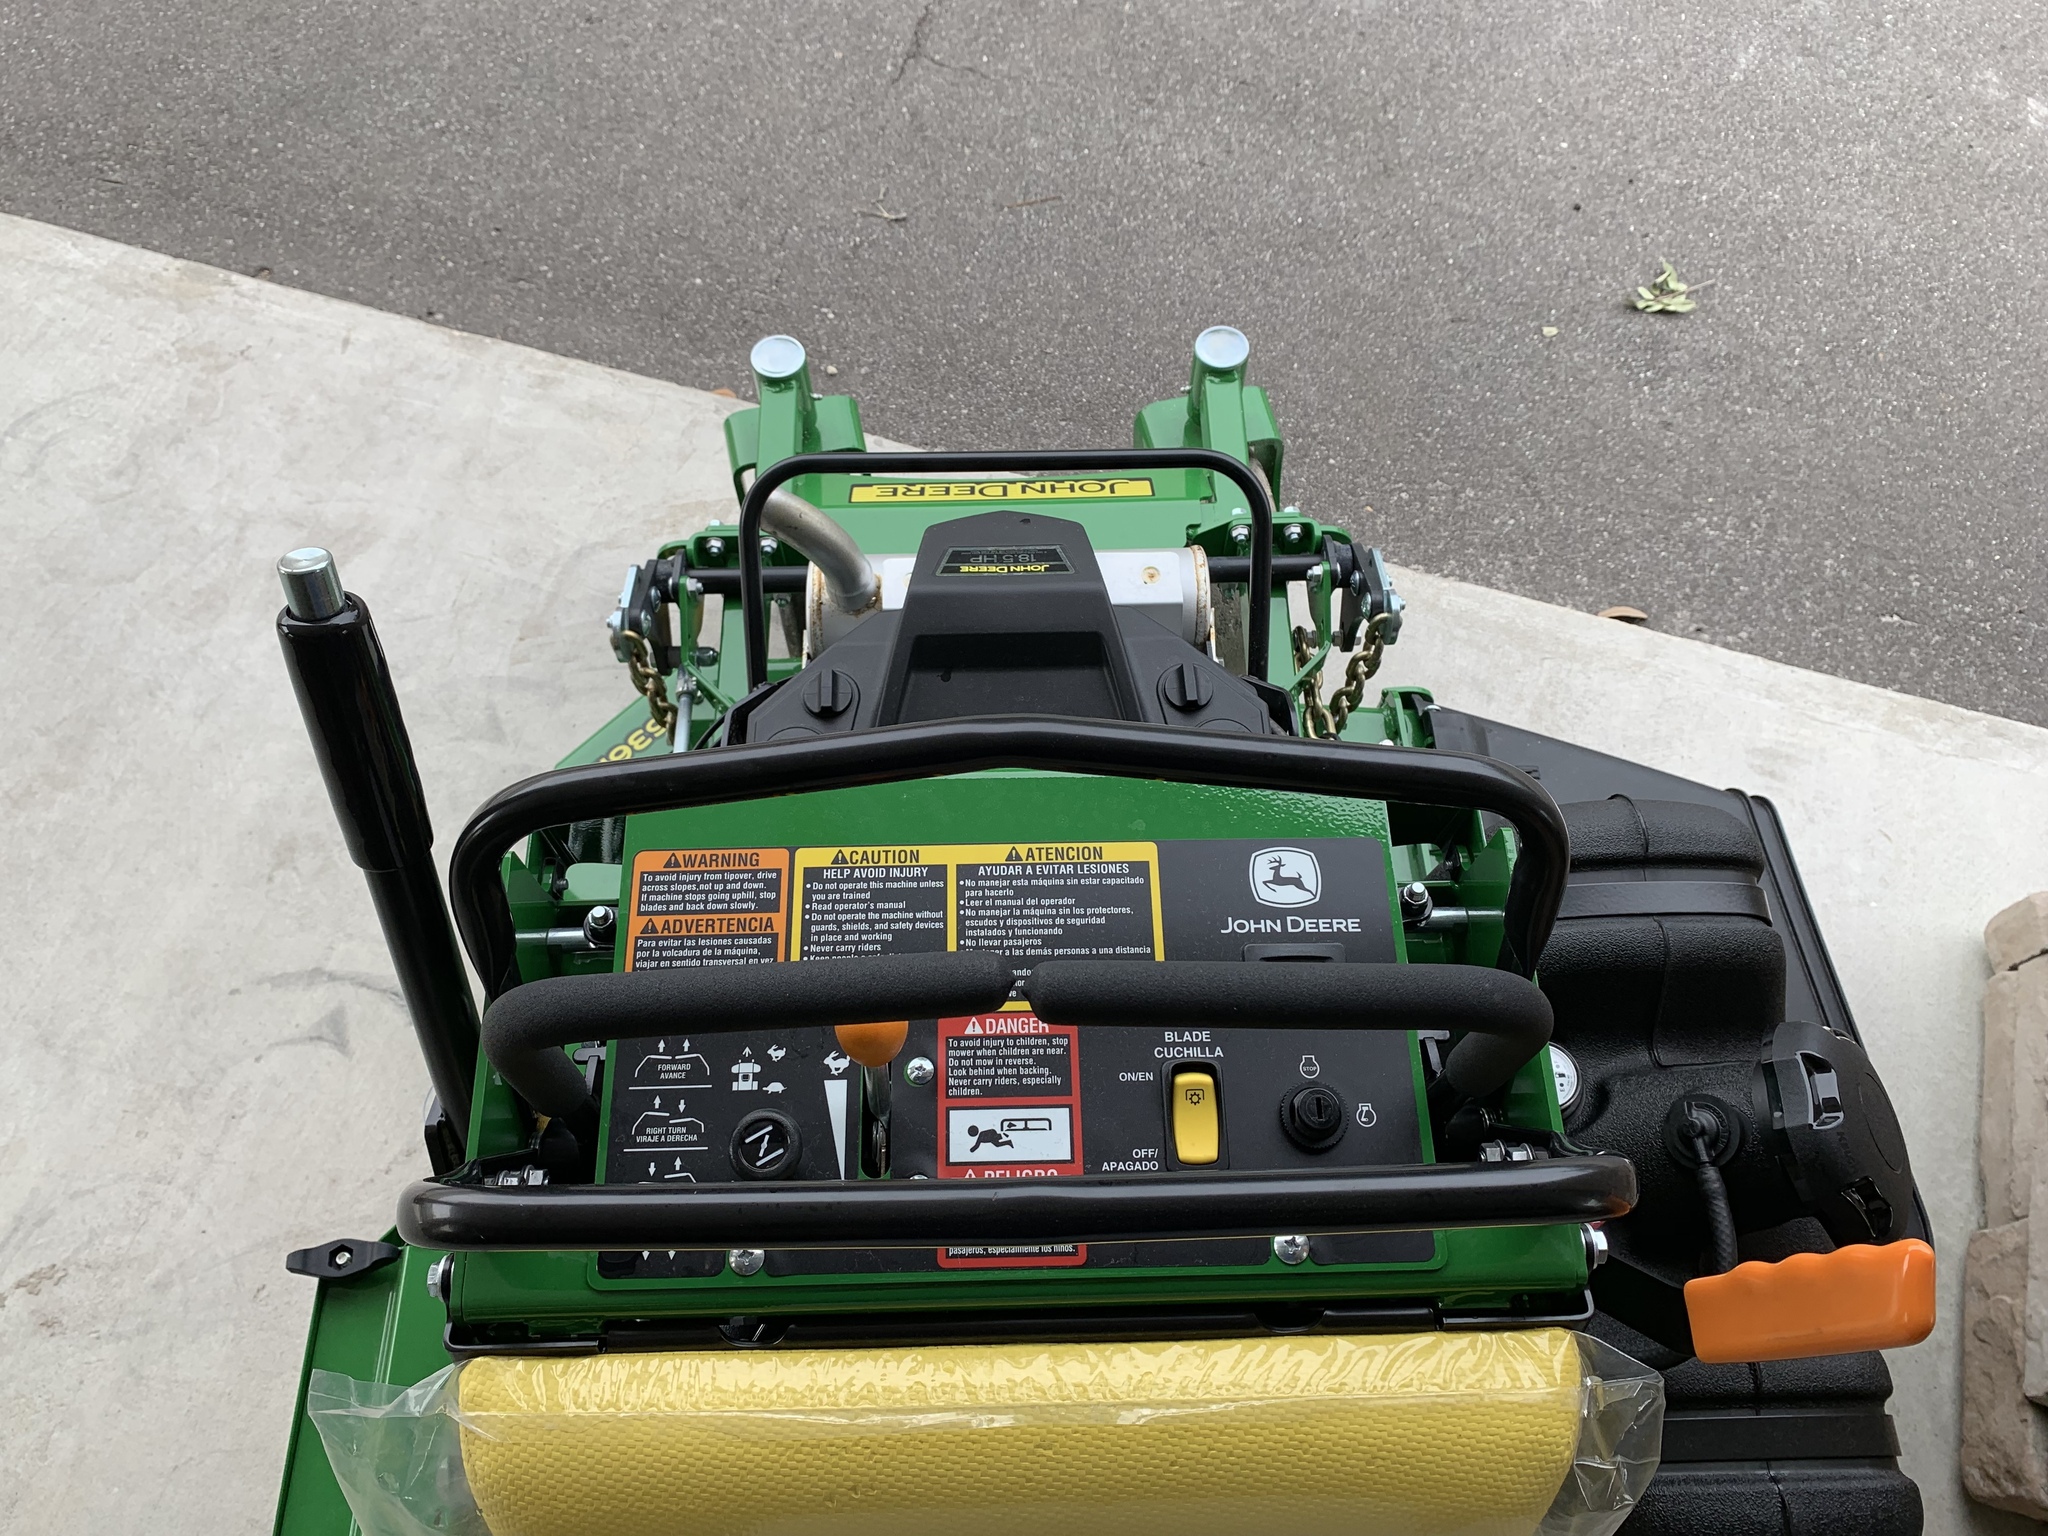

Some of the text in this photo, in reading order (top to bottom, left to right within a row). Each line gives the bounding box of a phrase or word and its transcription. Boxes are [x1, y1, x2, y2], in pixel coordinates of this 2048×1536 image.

[876, 480, 1129, 497] JOHN DEERE
[970, 554, 1036, 563] 18.5 HP
[960, 564, 1049, 573] JOHN DEERE
[849, 849, 919, 865] CAUTION
[1025, 846, 1102, 861] ATENCION
[682, 852, 759, 868] WARNING
[823, 867, 928, 879] HELP AVOID INJURY
[978, 863, 1129, 876] AYUDAR A EVITAR LESIONES
[643, 871, 777, 882] To avoid injury from tipover, drive
[978, 878, 1010, 887] manejar
[1012, 878, 1028, 886] esta
[1031, 877, 1064, 887] máquina
[1066, 877, 1078, 885] sin
[1080, 877, 1100, 885] estar
[1102, 876, 1144, 886] capacitado
[670, 883, 699, 892] slopes,
[714, 883, 723, 891] up
[726, 881, 740, 889] and
[743, 881, 766, 889] down.
[813, 882, 823, 890] Do
[839, 881, 868, 891] operate
[885, 880, 917, 888] machine
[641, 891, 776, 901] If machine stops going uphill, stop
[812, 894, 825, 902] you
[843, 891, 870, 899] trained
[965, 888, 1014, 898] para hacerlo
[640, 901, 758, 911] blades and back down slowly.
[812, 901, 905, 911] Read operator's manual
[985, 898, 992, 906] el
[995, 897, 1023, 906] manual
[1026, 897, 1038, 905] del
[1040, 897, 1075, 906] operador
[811, 913, 822, 921] Do
[837, 912, 866, 921] operate
[881, 911, 913, 919] machine
[915, 910, 943, 918] without
[965, 908, 976, 916] No
[978, 908, 1011, 917] manejar
[1023, 907, 1056, 916] máquina
[1059, 907, 1070, 915] sin
[1087, 906, 1133, 915] protectores,
[660, 917, 774, 934] ADVERTENCIA
[811, 921, 944, 933] guards, shields, and safety devices
[965, 918, 997, 926] escudos
[999, 919, 1004, 927] y
[1006, 917, 1053, 927] dispositivos
[1066, 916, 1105, 926] seguridad
[1221, 916, 1361, 933] JOHN DEERE
[820, 933, 842, 943] place
[844, 933, 859, 941] and
[861, 932, 892, 941] working
[966, 927, 1063, 937] instalados y funcionando
[637, 936, 772, 947] Para evitar las lesiones causadas
[965, 937, 1042, 947] No llevar pasajeros
[636, 947, 760, 959] por la volcadura de la máquina,
[810, 943, 881, 953] Never carry riders
[1026, 947, 1052, 955] demás
[1054, 948, 1090, 956] personas
[1115, 945, 1151, 954] distancia
[635, 959, 658, 969] viajar
[672, 958, 701, 967] sentido
[703, 957, 746, 966] transversal
[985, 1017, 1049, 1034] DANGER
[1165, 1031, 1211, 1042] BLADE
[948, 1037, 1068, 1048] To avoid injury to children, stop
[976, 1047, 996, 1056] when
[998, 1047, 1029, 1056] children
[1154, 1046, 1223, 1058] CUCHILLA
[658, 1063, 691, 1071] FORWARD
[948, 1058, 959, 1066] Do
[961, 1058, 973, 1066] not
[995, 1057, 1003, 1065] in
[948, 1067, 1051, 1077] Look behind when backing.
[1119, 1072, 1153, 1081] ON/EN
[949, 1075, 1061, 1087] Never carry riders, especially
[948, 1087, 982, 1096] children.
[667, 1134, 697, 1142] DERECHA
[1132, 1148, 1158, 1158] OFF/
[1102, 1161, 1158, 1171] APAGADO
